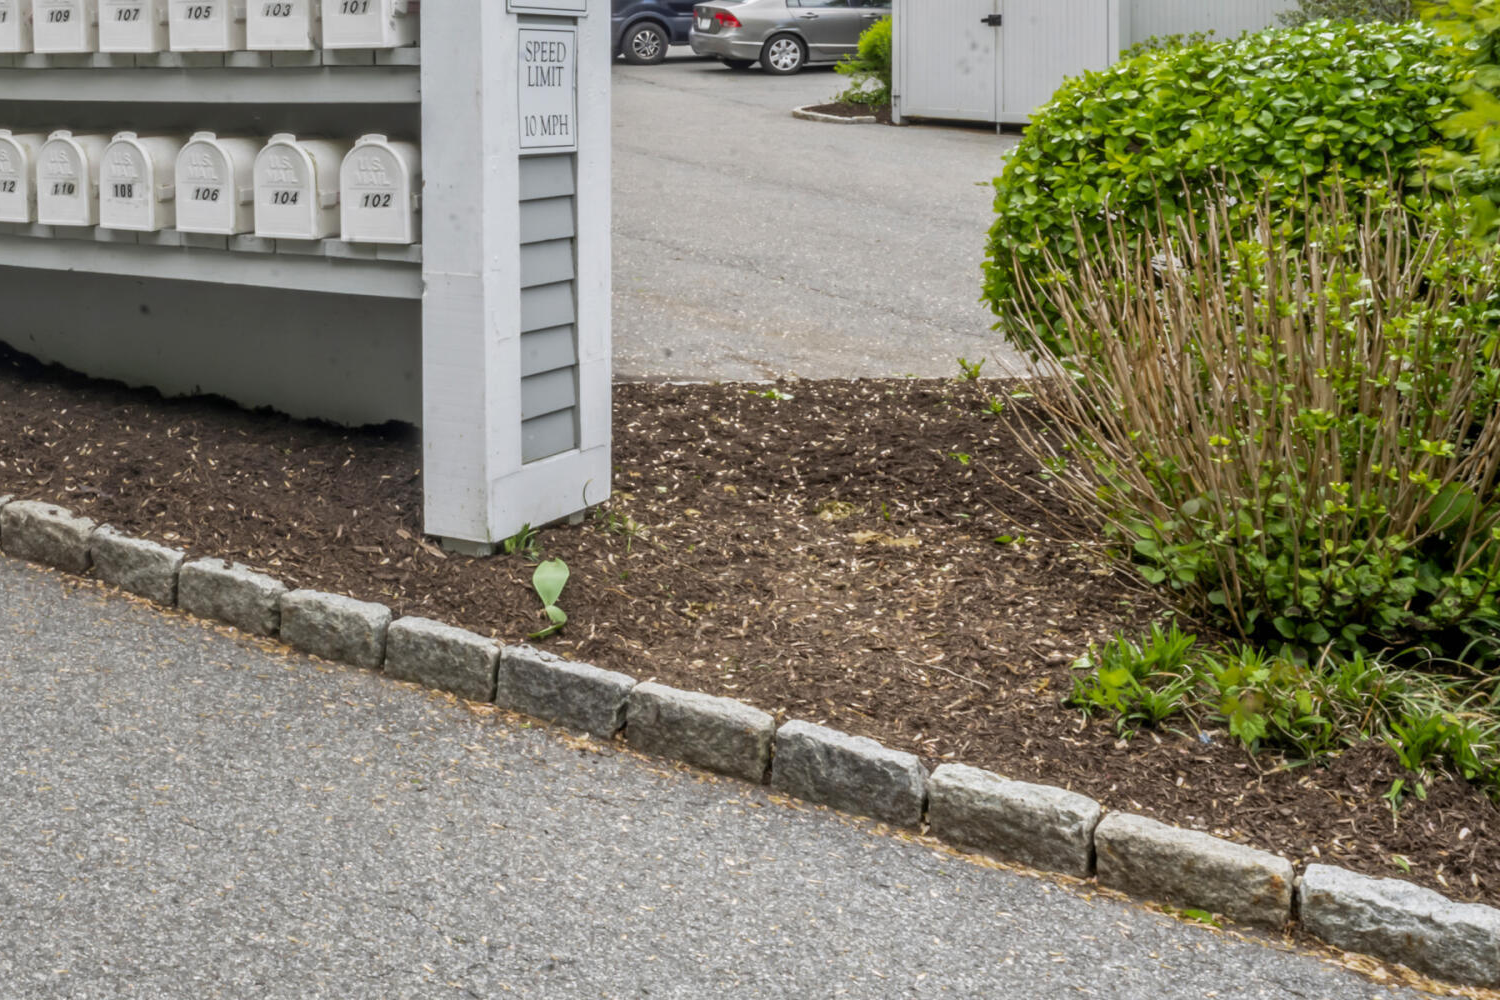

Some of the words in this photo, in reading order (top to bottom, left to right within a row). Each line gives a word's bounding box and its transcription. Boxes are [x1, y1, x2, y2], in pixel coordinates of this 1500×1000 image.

[187, 5, 212, 19] 105
[265, 3, 292, 17] 103
[343, 0, 368, 14] 101
[50, 10, 70, 22] 109
[117, 8, 140, 21] 107
[525, 41, 567, 63] SPEED
[527, 65, 564, 87] LIMIT
[525, 115, 537, 136] 10
[540, 115, 569, 136] MPH
[53, 182, 75, 195] 110
[114, 184, 133, 198] 108
[195, 188, 219, 201] 106
[274, 191, 298, 204] 104
[364, 194, 391, 208] 102
